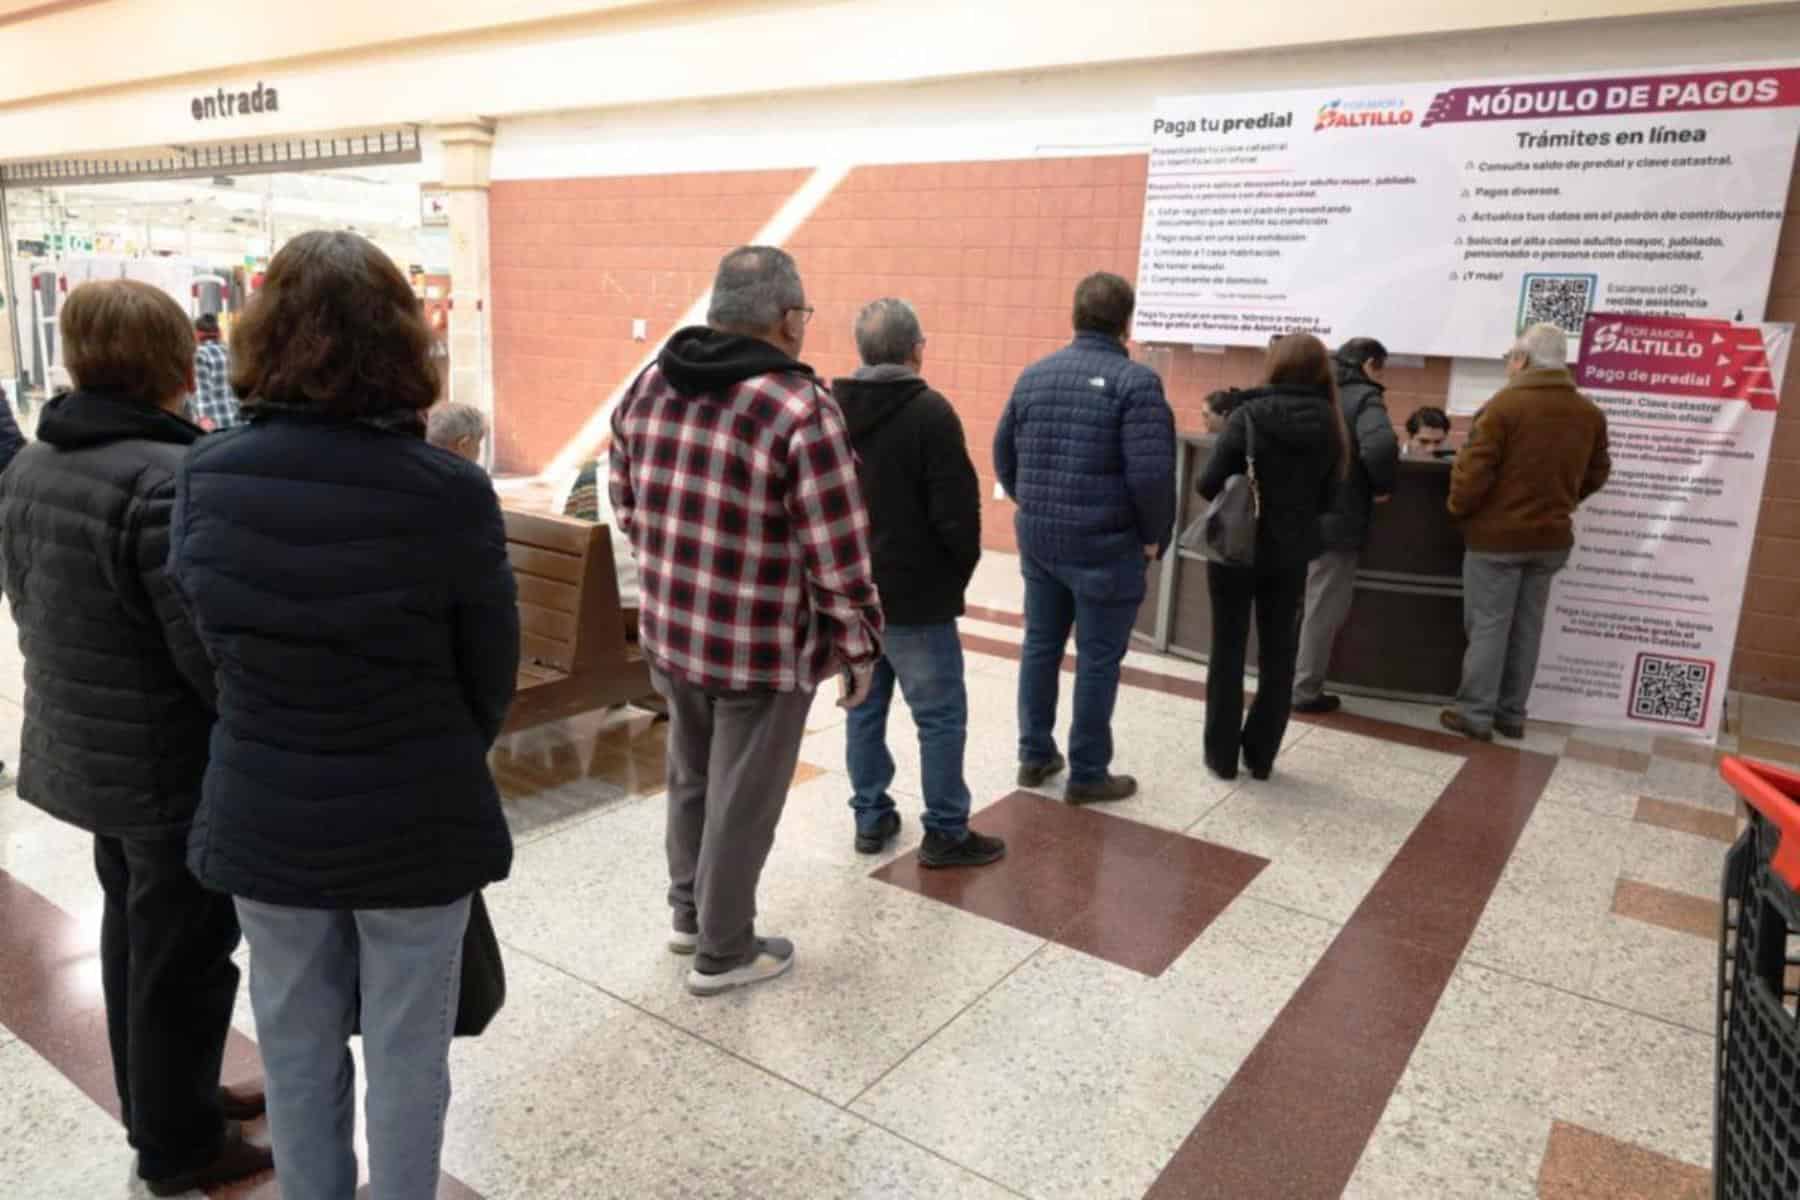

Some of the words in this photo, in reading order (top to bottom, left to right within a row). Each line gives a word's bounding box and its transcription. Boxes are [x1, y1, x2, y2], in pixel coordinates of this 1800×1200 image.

[191, 81, 280, 120] entrada
[1465, 86, 1598, 118] MÓDULO
[1604, 84, 1651, 111] DE
[1657, 78, 1781, 108] PAGOS
[1153, 118, 1197, 138] Paga
[1199, 116, 1220, 133] tu
[1222, 112, 1293, 134] predial
[1515, 128, 1612, 150] Trámites
[1615, 131, 1646, 146] en
[1648, 125, 1708, 145] línea
[1478, 160, 1530, 172] Consulta
[1532, 159, 1563, 171] saldo
[1565, 158, 1580, 170] de
[1581, 157, 1625, 172] predial
[1636, 156, 1670, 169] clave
[1474, 185, 1509, 198] Pagos
[1288, 204, 1352, 216] presentando
[1471, 210, 1525, 221] Actualiza
[1526, 210, 1546, 221] tus
[1547, 209, 1582, 221] datos
[1583, 211, 1599, 220] en
[1600, 209, 1613, 220] el
[1613, 209, 1659, 223] padrón
[1660, 209, 1678, 221] de
[1466, 234, 1509, 246] Solicita
[1510, 235, 1523, 246] el
[1523, 235, 1547, 246] alta
[1548, 236, 1582, 246] como
[1583, 234, 1623, 246] adulto
[1463, 248, 1530, 261] pensionado
[1540, 250, 1590, 262] persona
[1591, 250, 1616, 260] con
[1604, 296, 1643, 307] recibe
[1645, 298, 1709, 309] asistencia
[1623, 326, 1650, 338] POR
[1650, 328, 1686, 340] AMOR
[1687, 330, 1696, 341] A
[1584, 365, 1626, 385] Pago
[1627, 369, 1649, 383] de
[1650, 371, 1712, 388] predial
[1671, 400, 1721, 413] catastral
